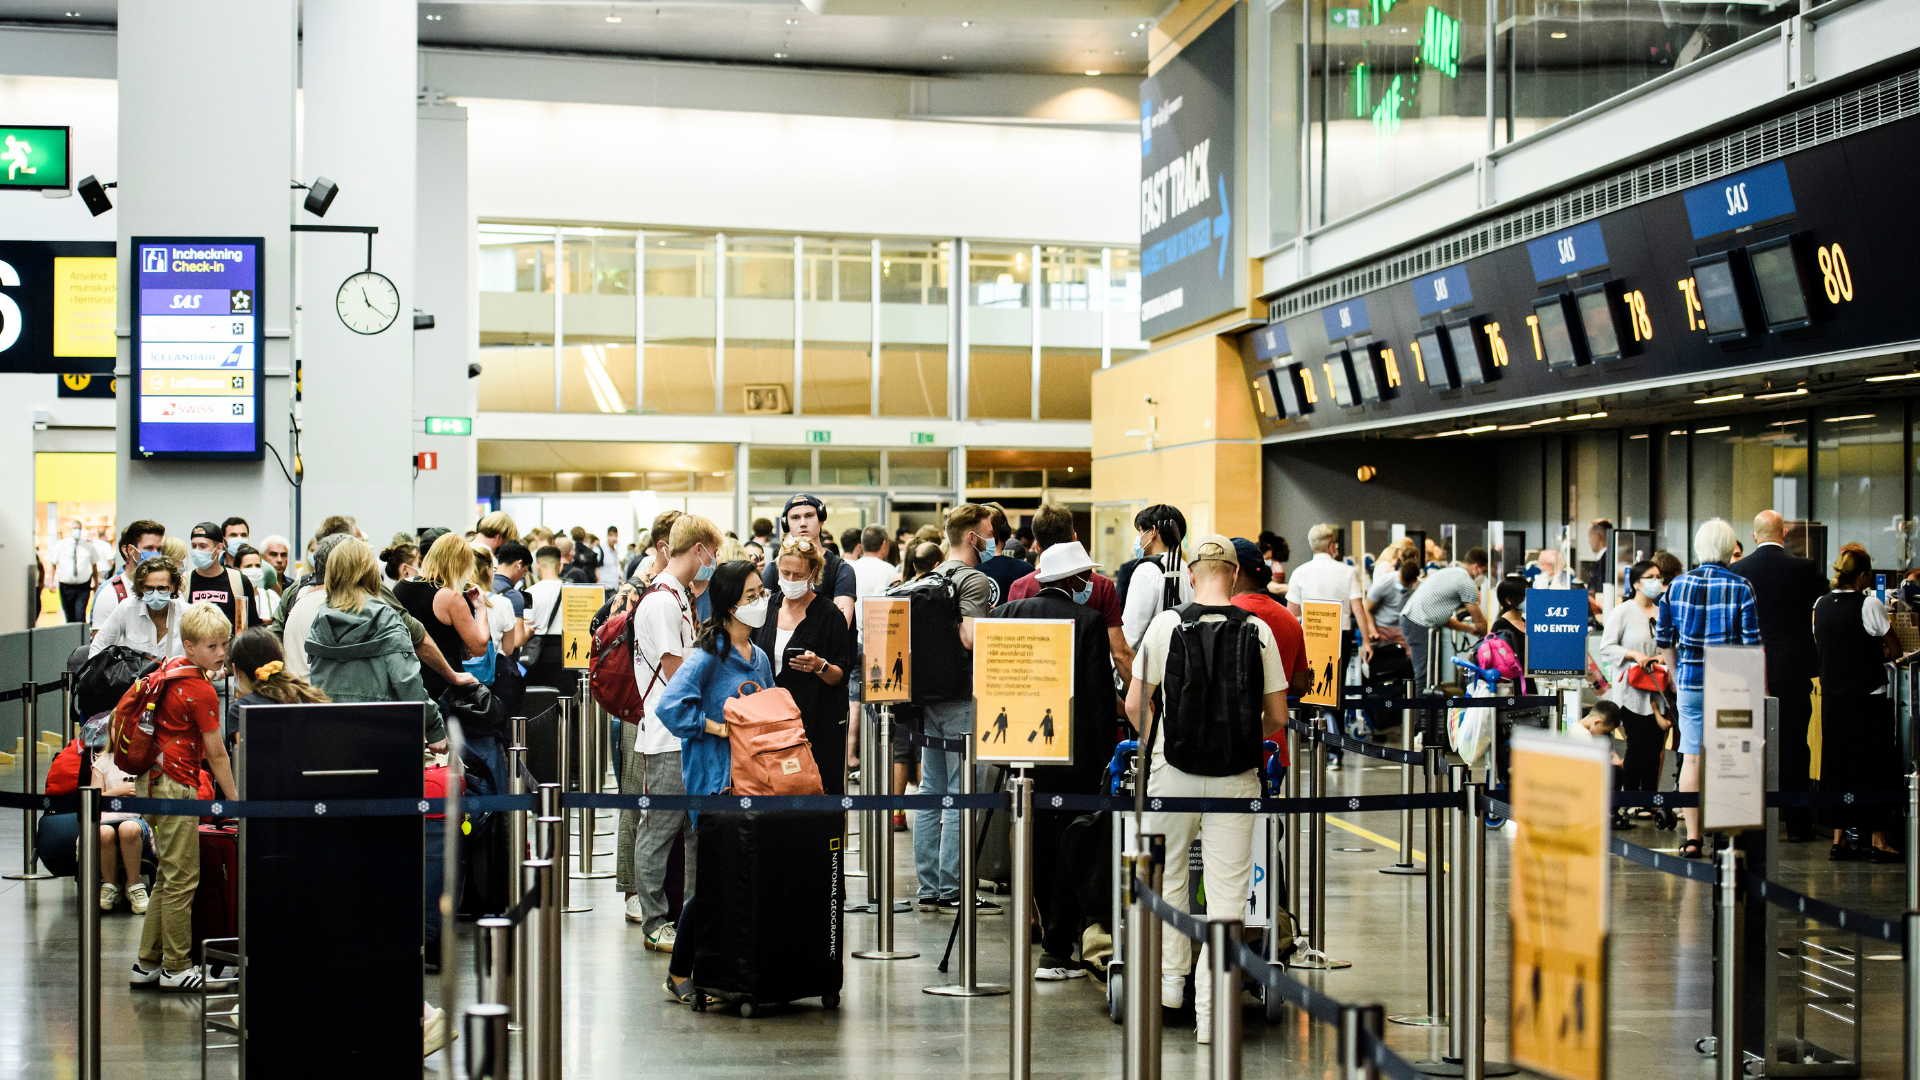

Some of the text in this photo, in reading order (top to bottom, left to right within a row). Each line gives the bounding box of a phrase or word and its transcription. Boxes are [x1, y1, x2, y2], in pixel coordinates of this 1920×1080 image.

[1423, 5, 1459, 79] AIR!
[1141, 138, 1210, 235] FAST TRACK
[1725, 182, 1749, 216] SAS
[172, 247, 243, 263] Incheckning
[1557, 236, 1576, 264] SAS
[172, 260, 225, 273] Check-in
[1818, 243, 1854, 304] 80
[70, 271, 107, 281] Använd
[70, 283, 117, 294] munskyd
[1433, 276, 1449, 302] SAS
[169, 294, 203, 309] SAS
[70, 310, 89, 319] Use
[1623, 289, 1653, 341] 78
[70, 322, 96, 331] mask
[98, 322, 107, 331] in
[1484, 321, 1509, 367] 76
[151, 353, 216, 361] ICELANDAIR
[178, 405, 214, 414] SWISS
[1545, 606, 1570, 617] SAS
[1533, 623, 1580, 633] NO ENTRY
[829, 898, 837, 958] GEOGRAPHIC
